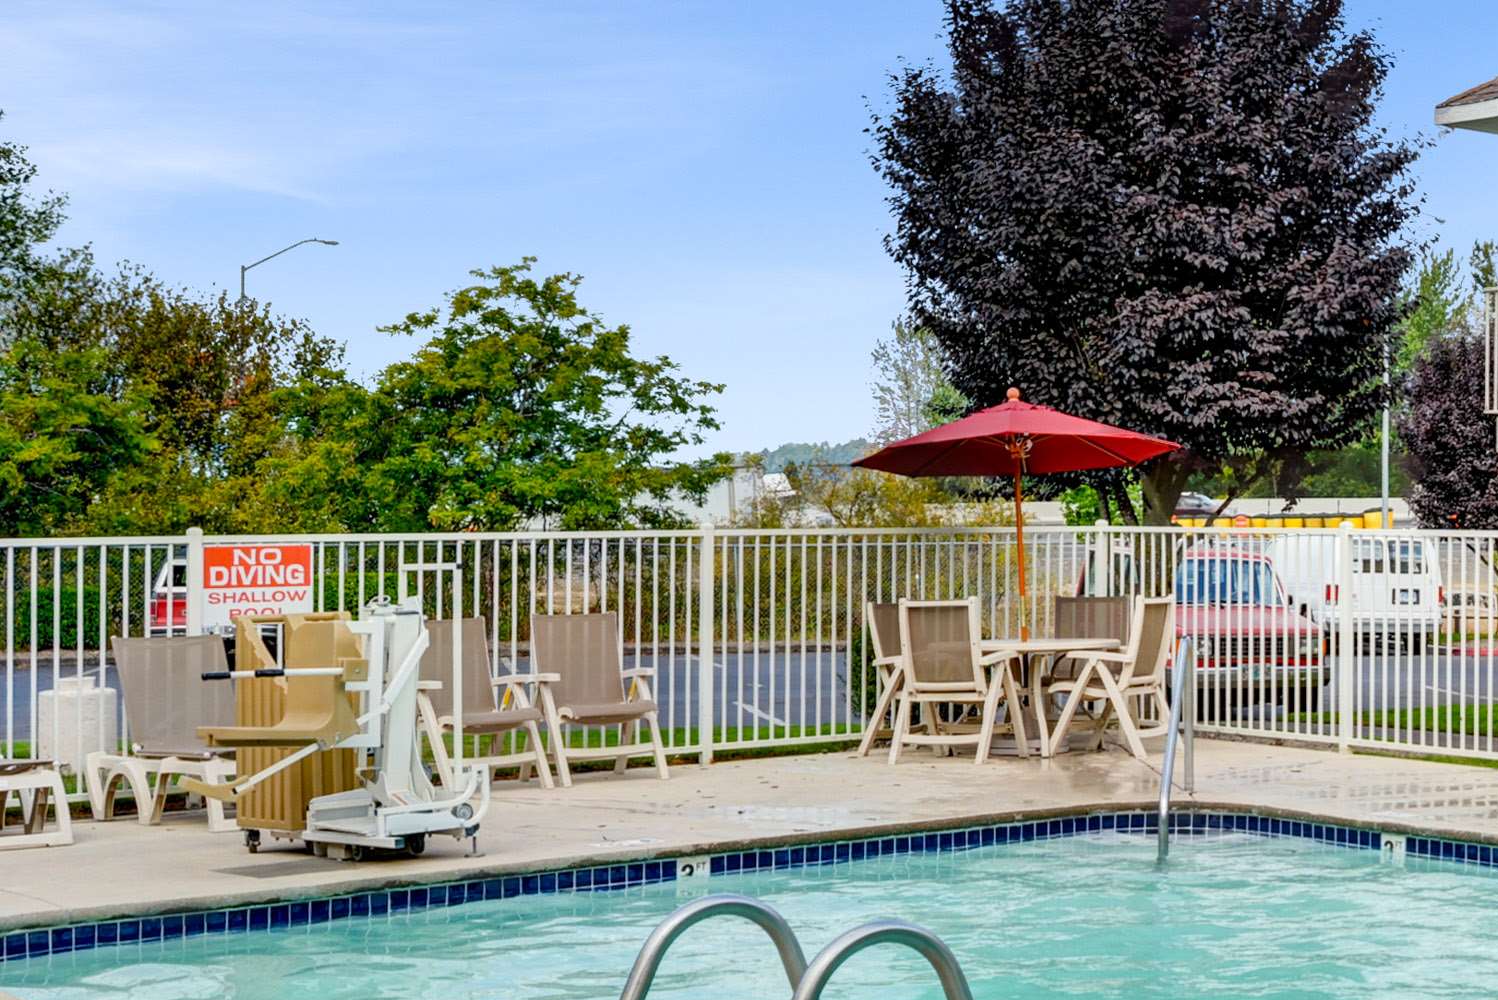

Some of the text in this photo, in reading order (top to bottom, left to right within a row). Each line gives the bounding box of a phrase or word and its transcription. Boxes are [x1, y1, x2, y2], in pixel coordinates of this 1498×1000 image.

[233, 548, 282, 566] NO
[209, 564, 305, 586] DIVING
[208, 590, 306, 605] SHALLOW
